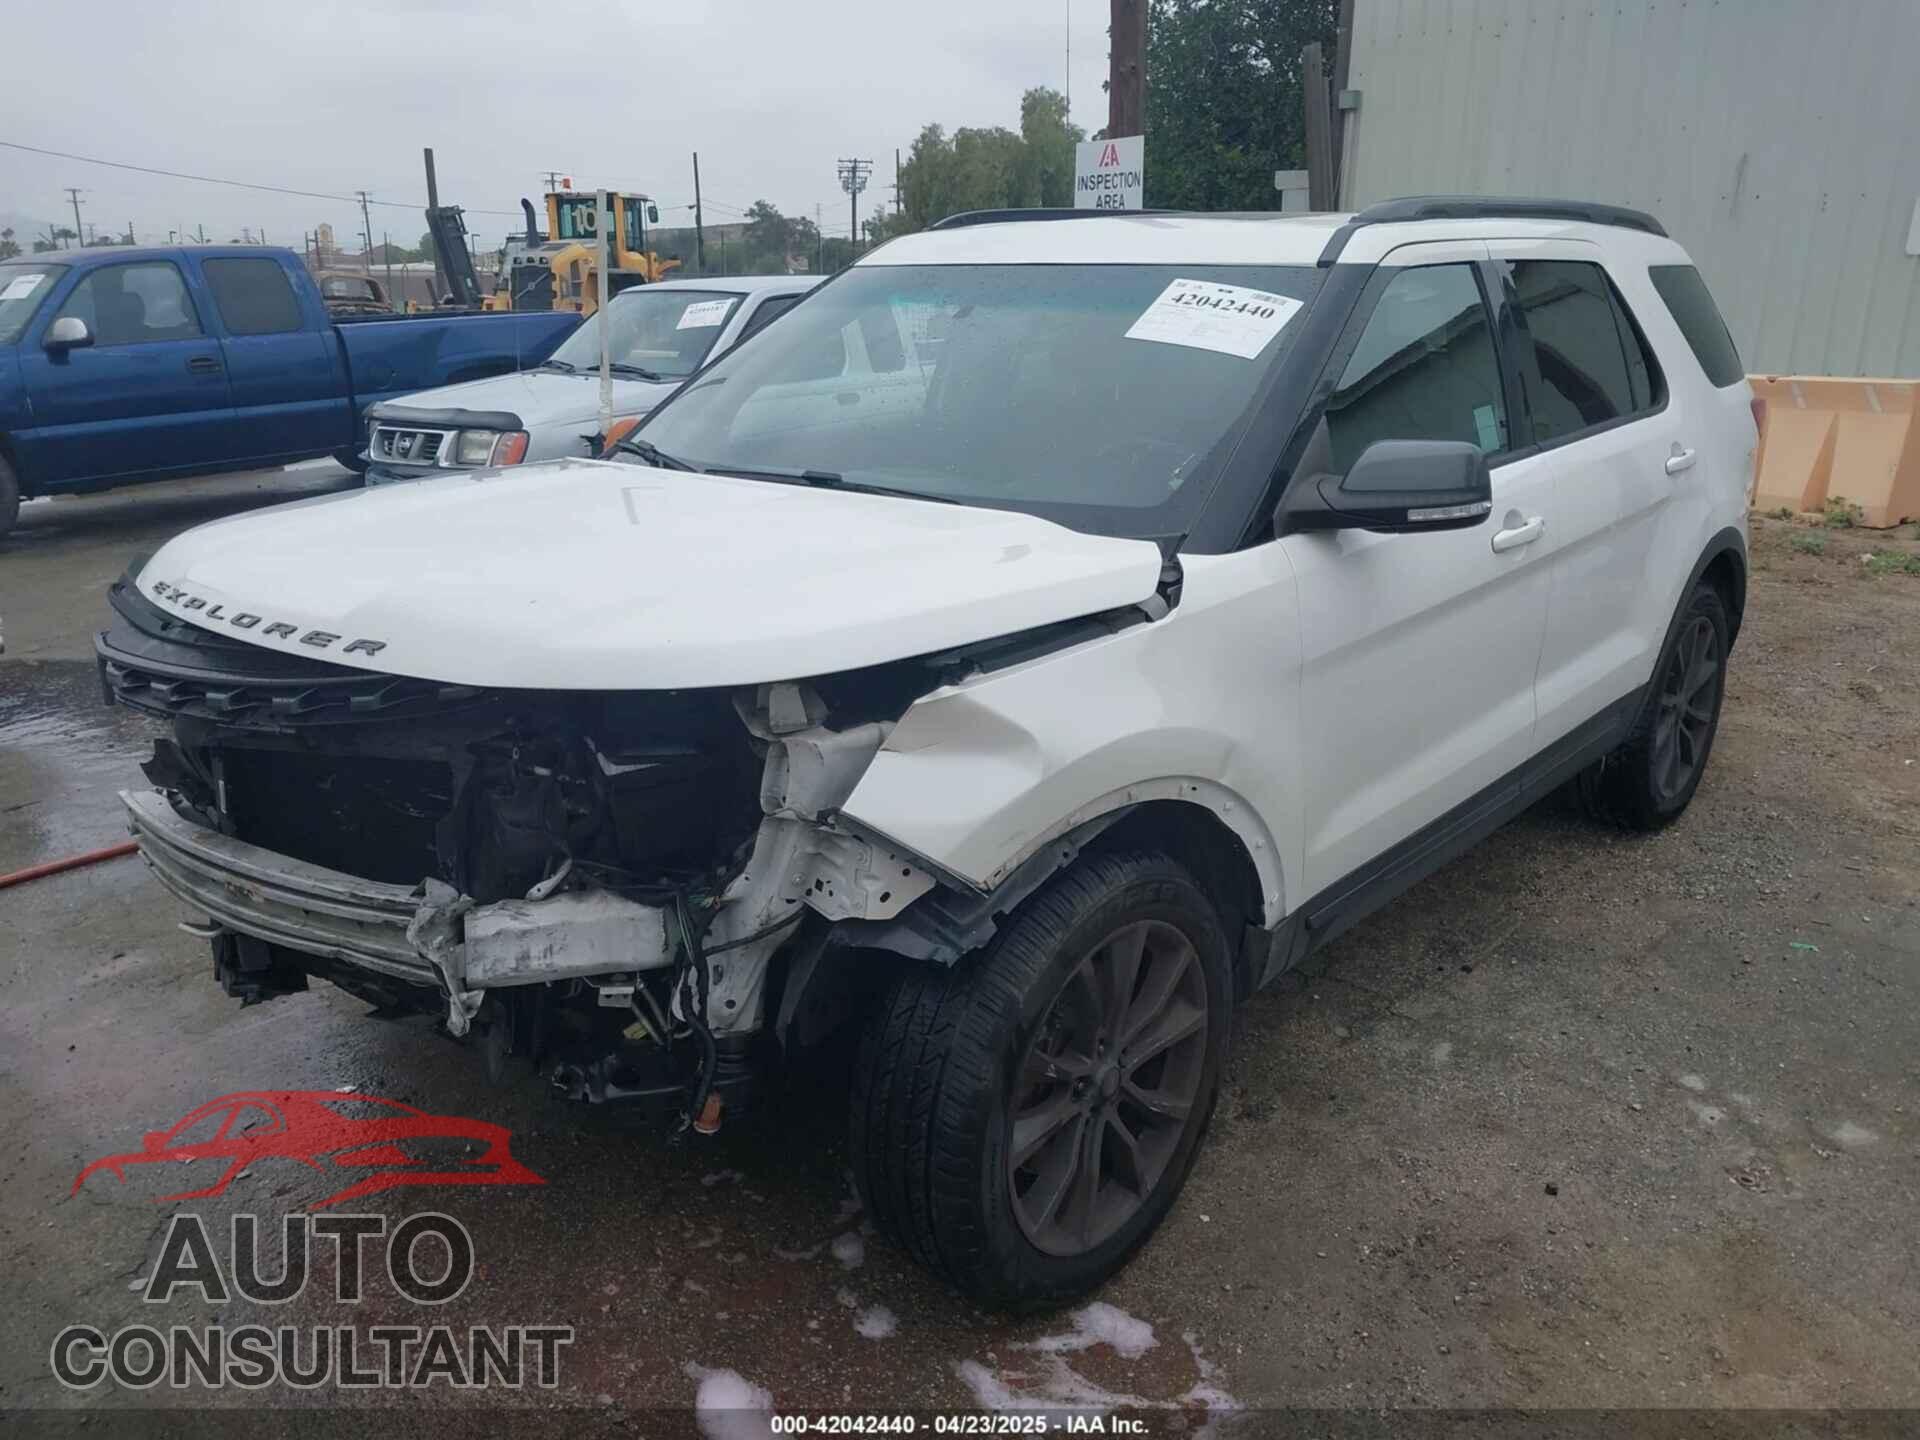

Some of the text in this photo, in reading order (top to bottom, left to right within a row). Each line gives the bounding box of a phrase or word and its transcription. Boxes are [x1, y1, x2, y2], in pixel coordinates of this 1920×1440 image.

[1077, 171, 1141, 191] INSPECTION
[1096, 193, 1125, 209] AREA
[1170, 292, 1276, 320] 42042440
[152, 580, 387, 656] EXPLORER
